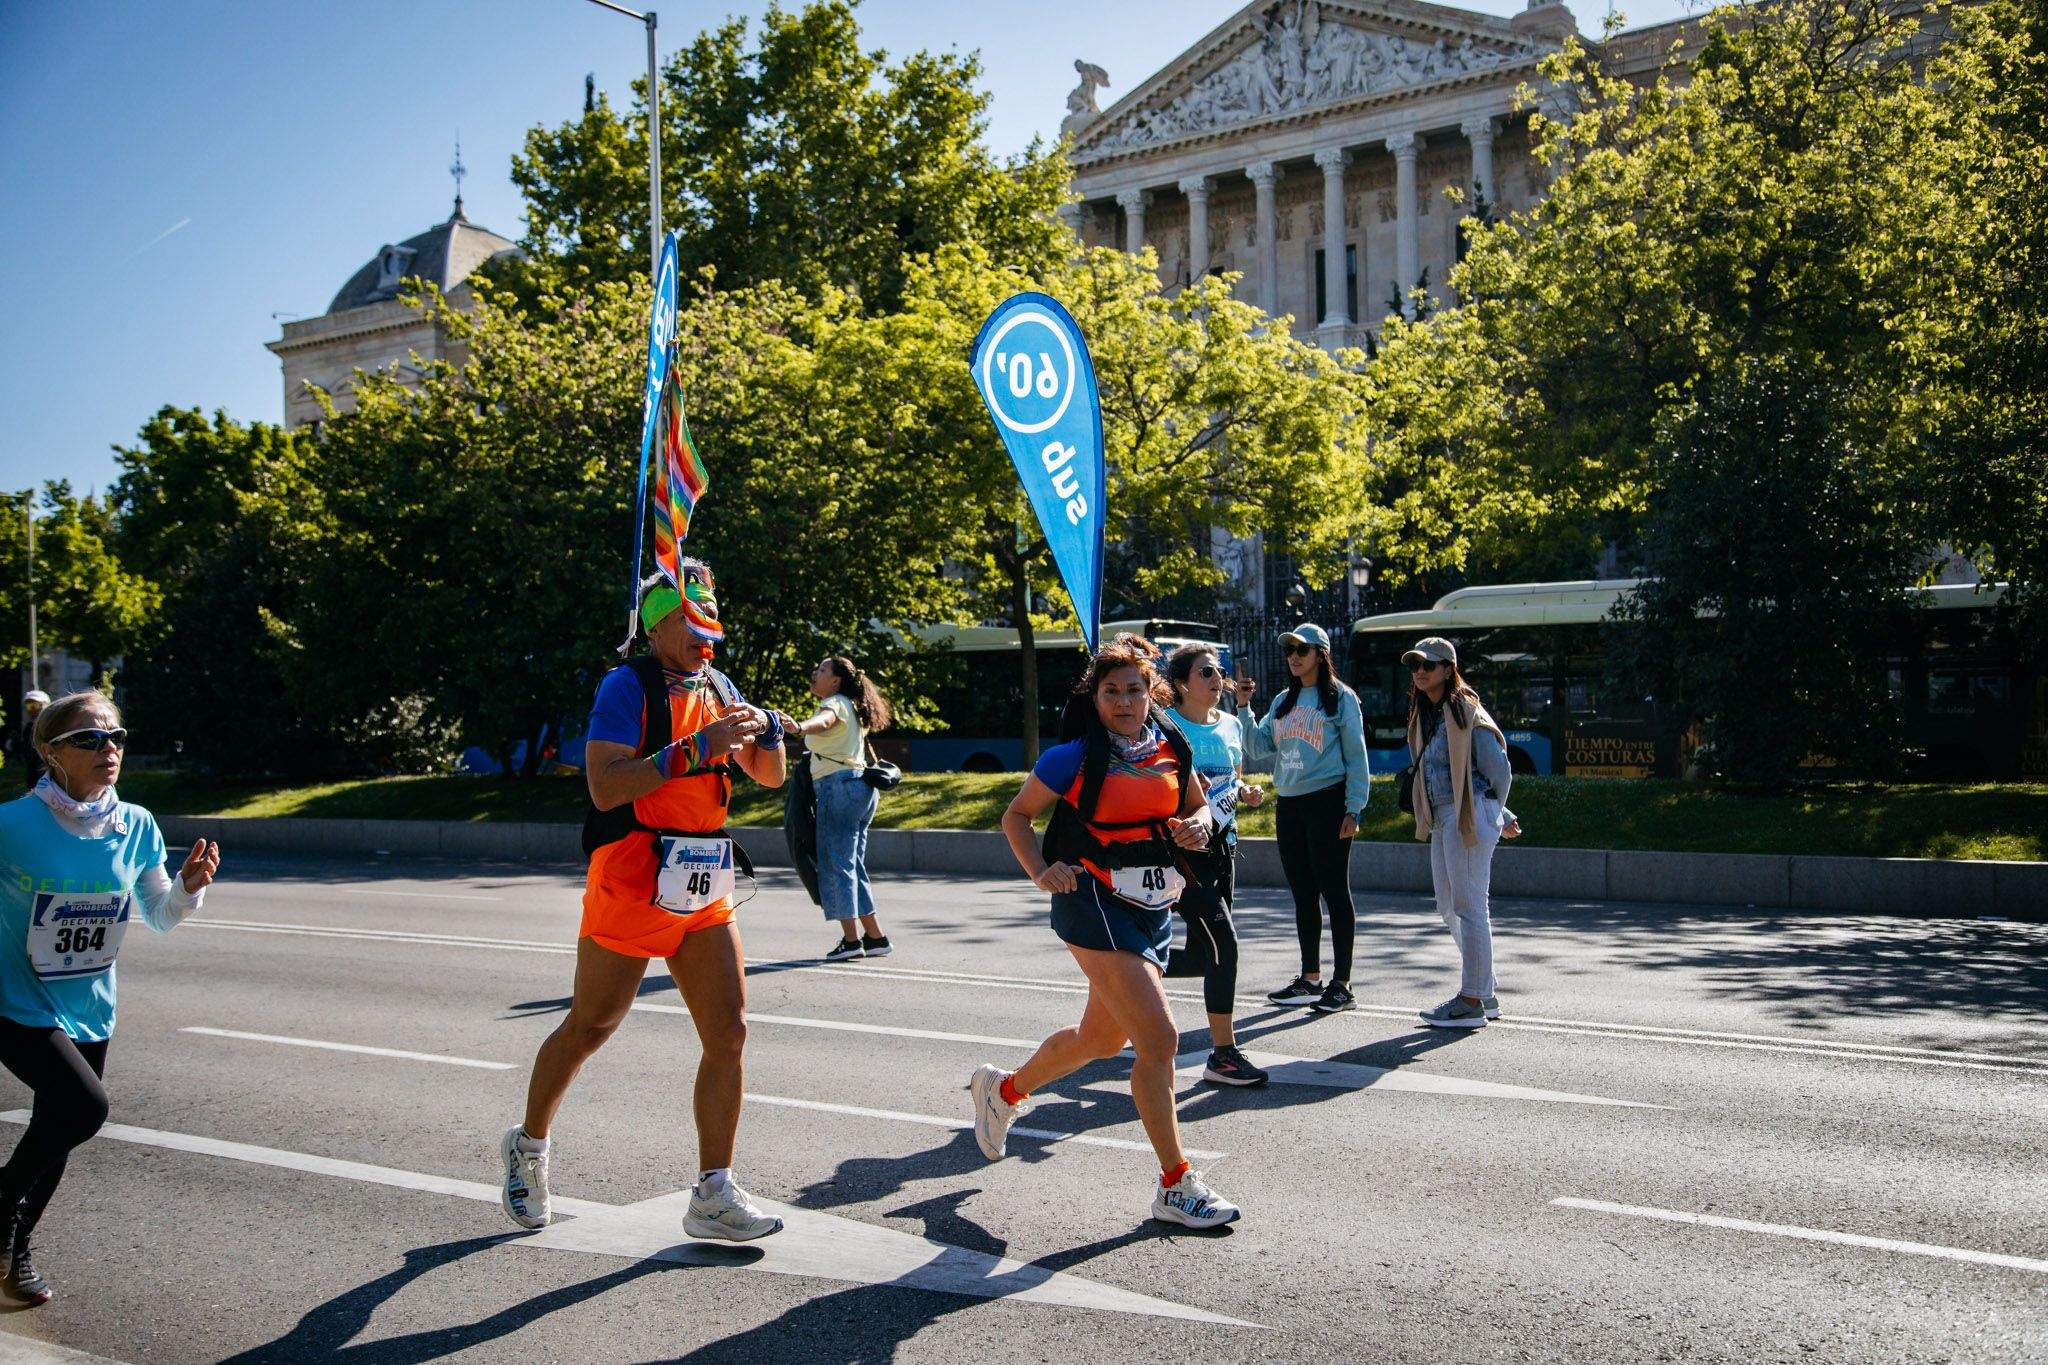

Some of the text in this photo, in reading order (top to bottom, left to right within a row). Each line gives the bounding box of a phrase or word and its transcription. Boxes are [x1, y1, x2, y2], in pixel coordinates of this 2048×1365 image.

[1567, 738, 1623, 750] TIEMPO
[1565, 750, 1656, 764] COSTURAS
[687, 872, 711, 896] 46
[1143, 867, 1166, 891] 48
[70, 904, 119, 912] BOMBEROS
[61, 918, 114, 926] DECIMAS
[54, 926, 106, 954] 364
